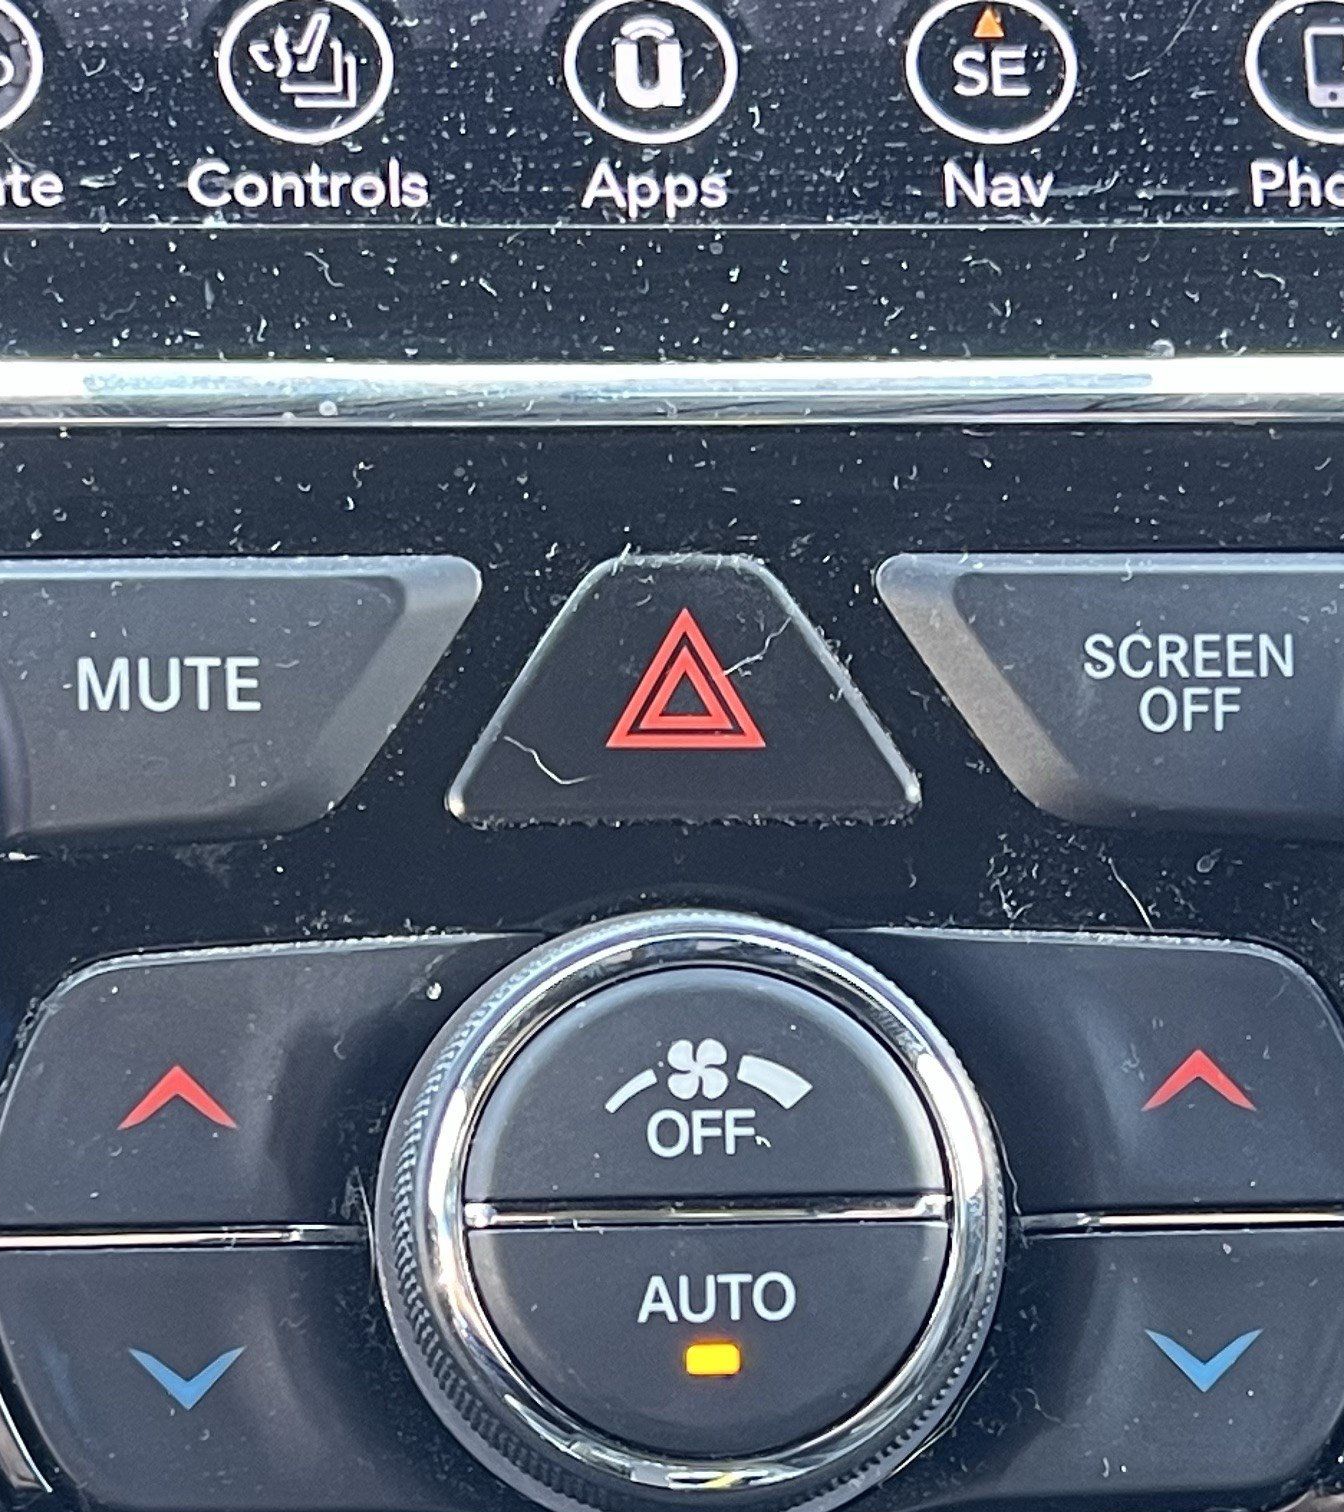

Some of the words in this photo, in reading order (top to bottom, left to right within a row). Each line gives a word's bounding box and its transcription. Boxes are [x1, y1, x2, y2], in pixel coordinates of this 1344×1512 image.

[953, 46, 1032, 98] SE
[186, 159, 430, 208] Controls
[582, 164, 728, 219] Apps
[943, 163, 1054, 207] Nav
[1083, 632, 1295, 680] SCREEN
[76, 656, 262, 713] MUTE
[1138, 685, 1242, 733] OFF
[646, 1108, 757, 1159] OFF
[637, 1271, 797, 1324] AUTO
